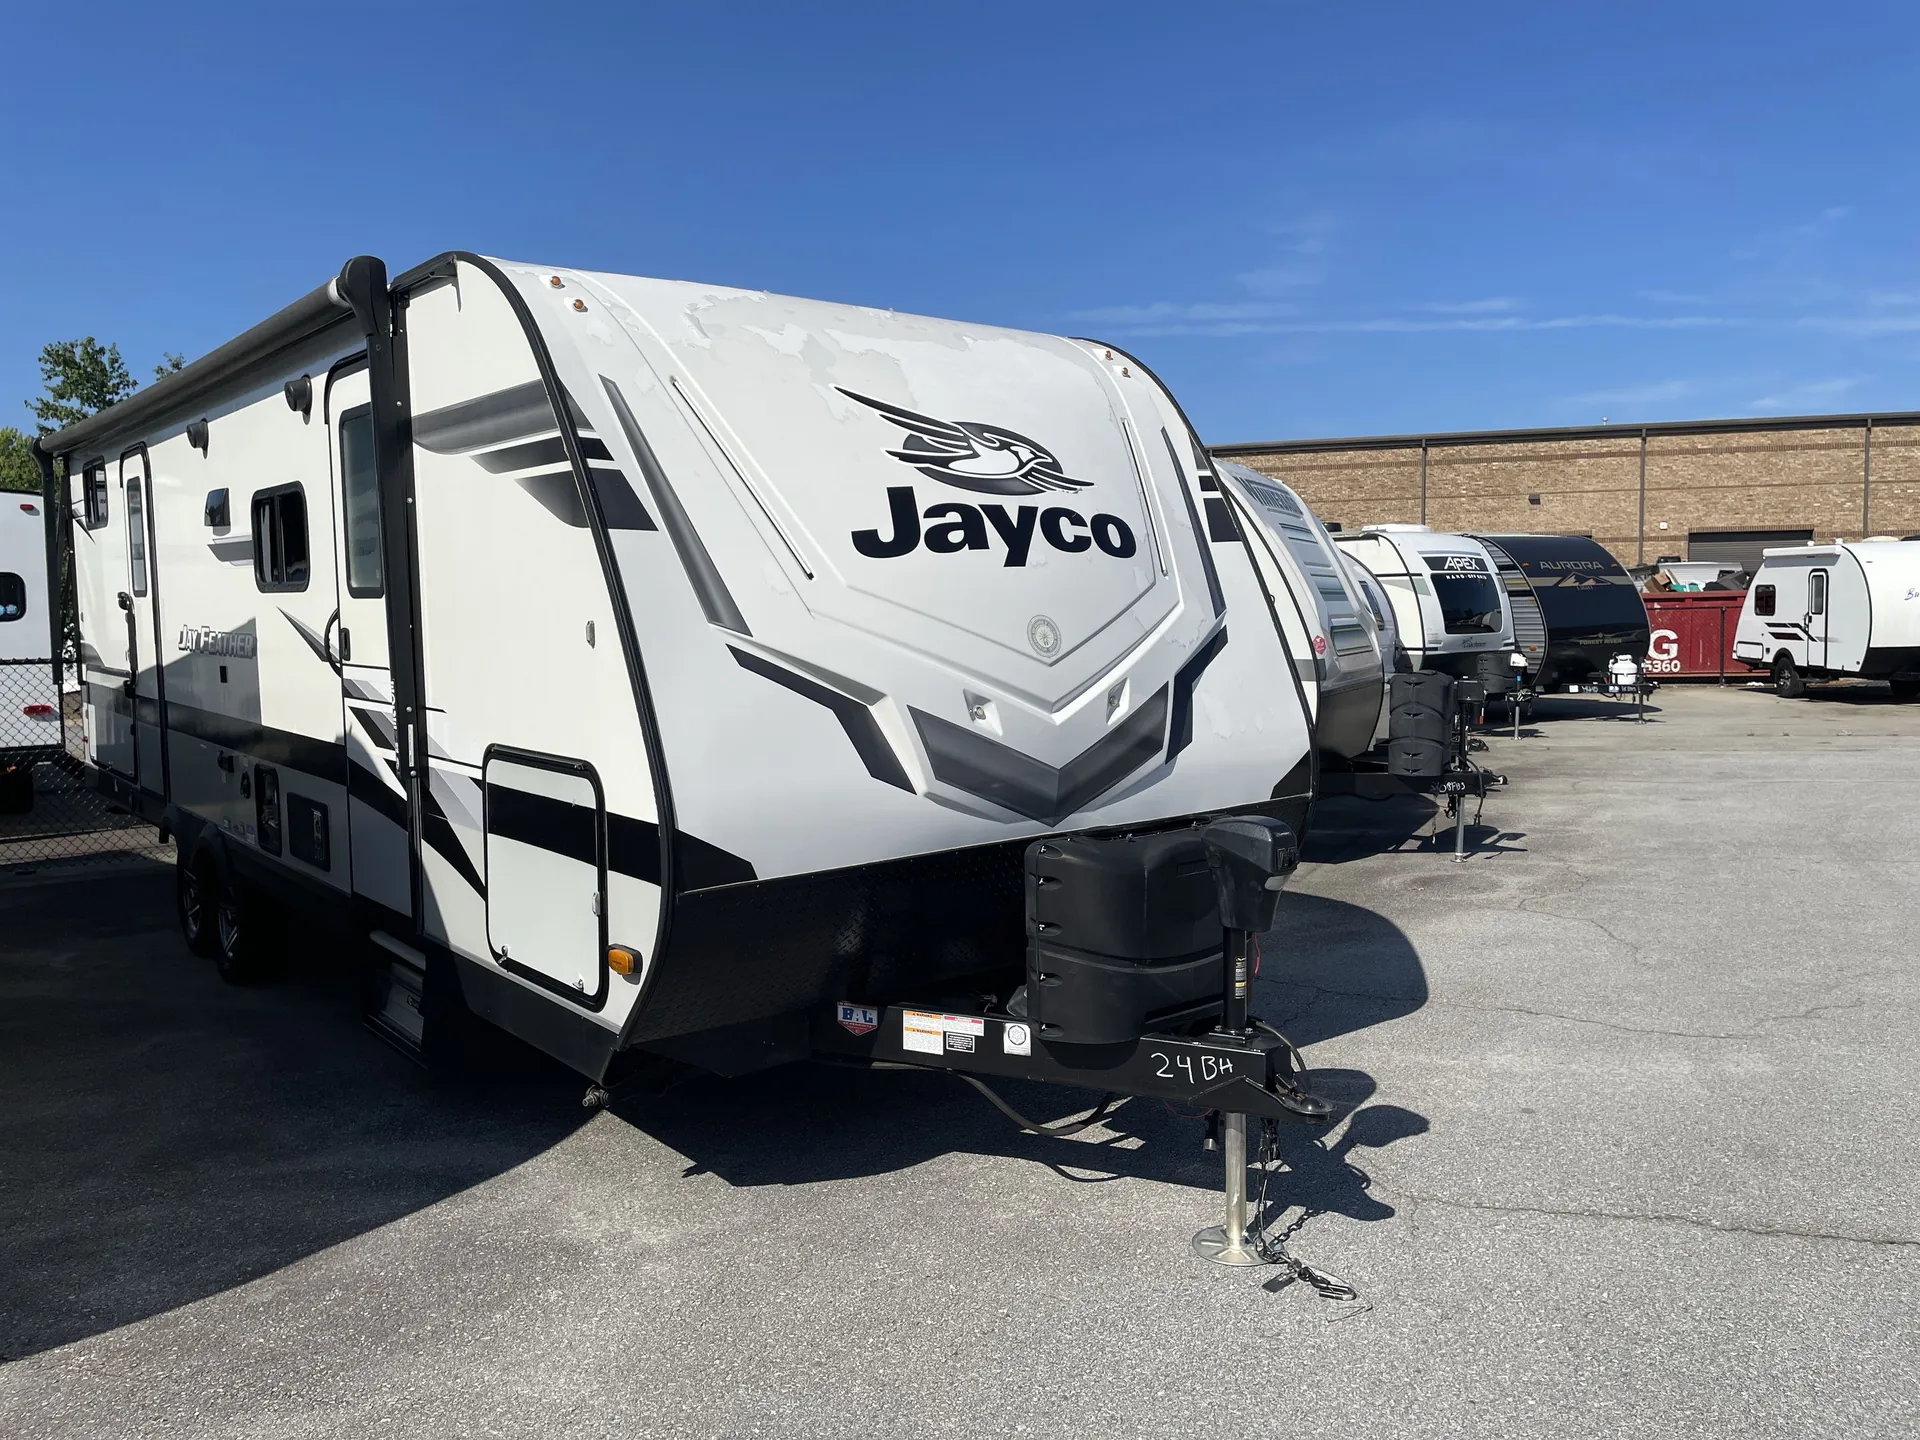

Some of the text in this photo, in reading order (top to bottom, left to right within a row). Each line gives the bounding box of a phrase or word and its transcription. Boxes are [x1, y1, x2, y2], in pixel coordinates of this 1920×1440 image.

[850, 486, 1137, 568] Jayco
[1443, 556, 1480, 571] APEX
[1540, 561, 1604, 570] AURORA
[178, 624, 258, 659] JAY FEATHER
